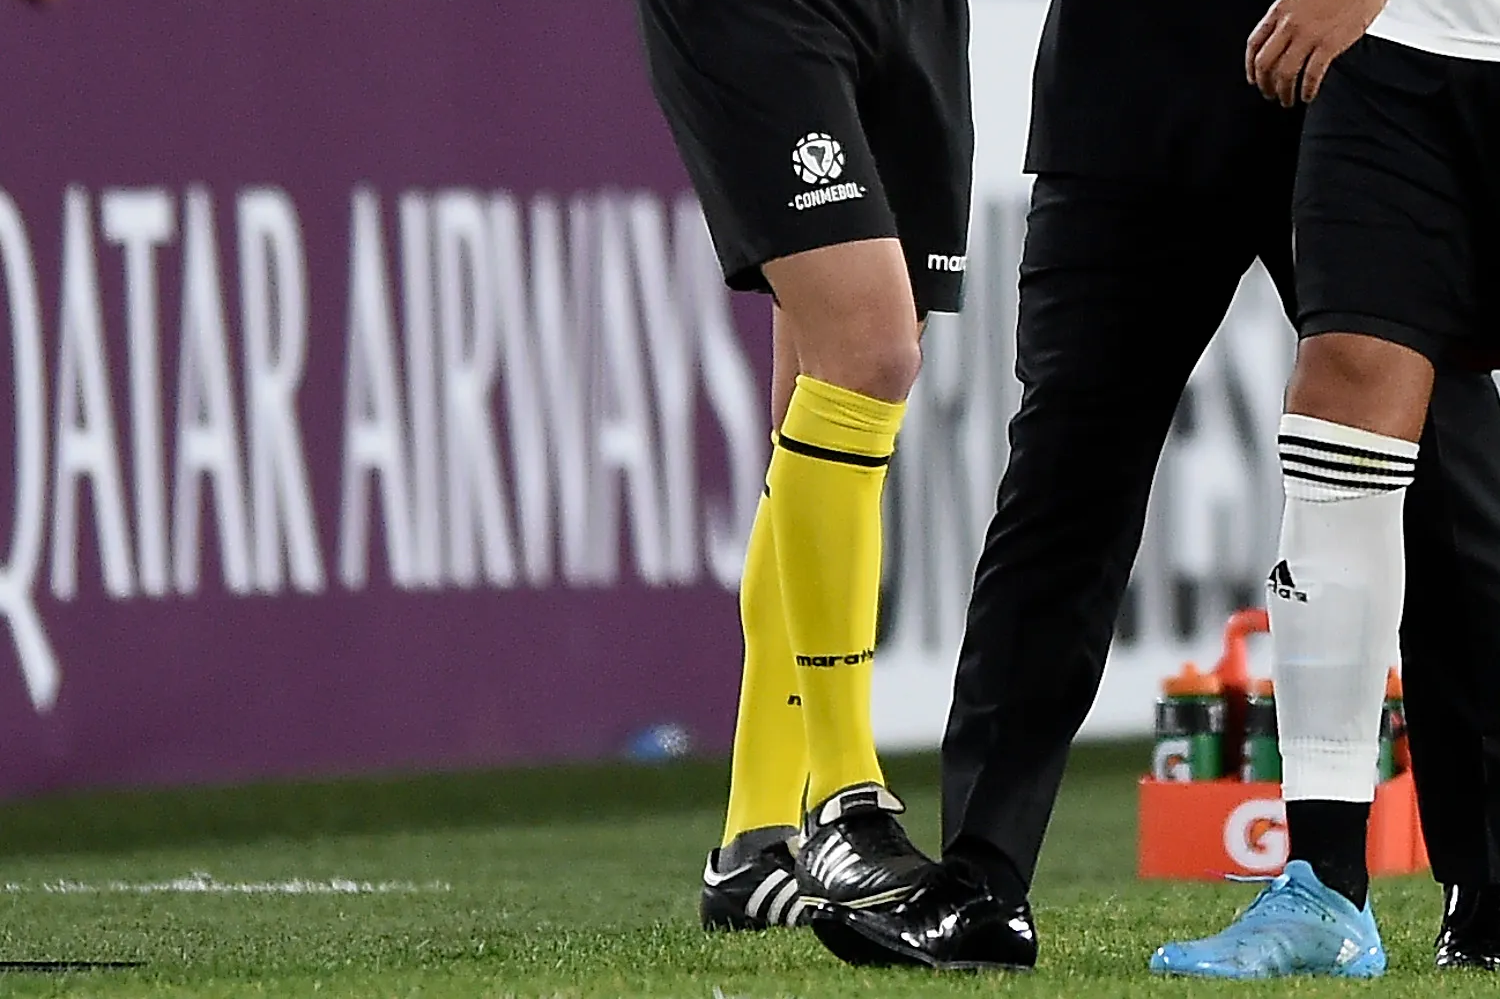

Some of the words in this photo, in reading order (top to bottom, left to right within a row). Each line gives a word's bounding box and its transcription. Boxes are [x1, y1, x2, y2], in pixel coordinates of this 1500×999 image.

[794, 182, 863, 211] CONMEBOL
[338, 182, 764, 594] AIRWAYS
[1223, 800, 1291, 872] G
